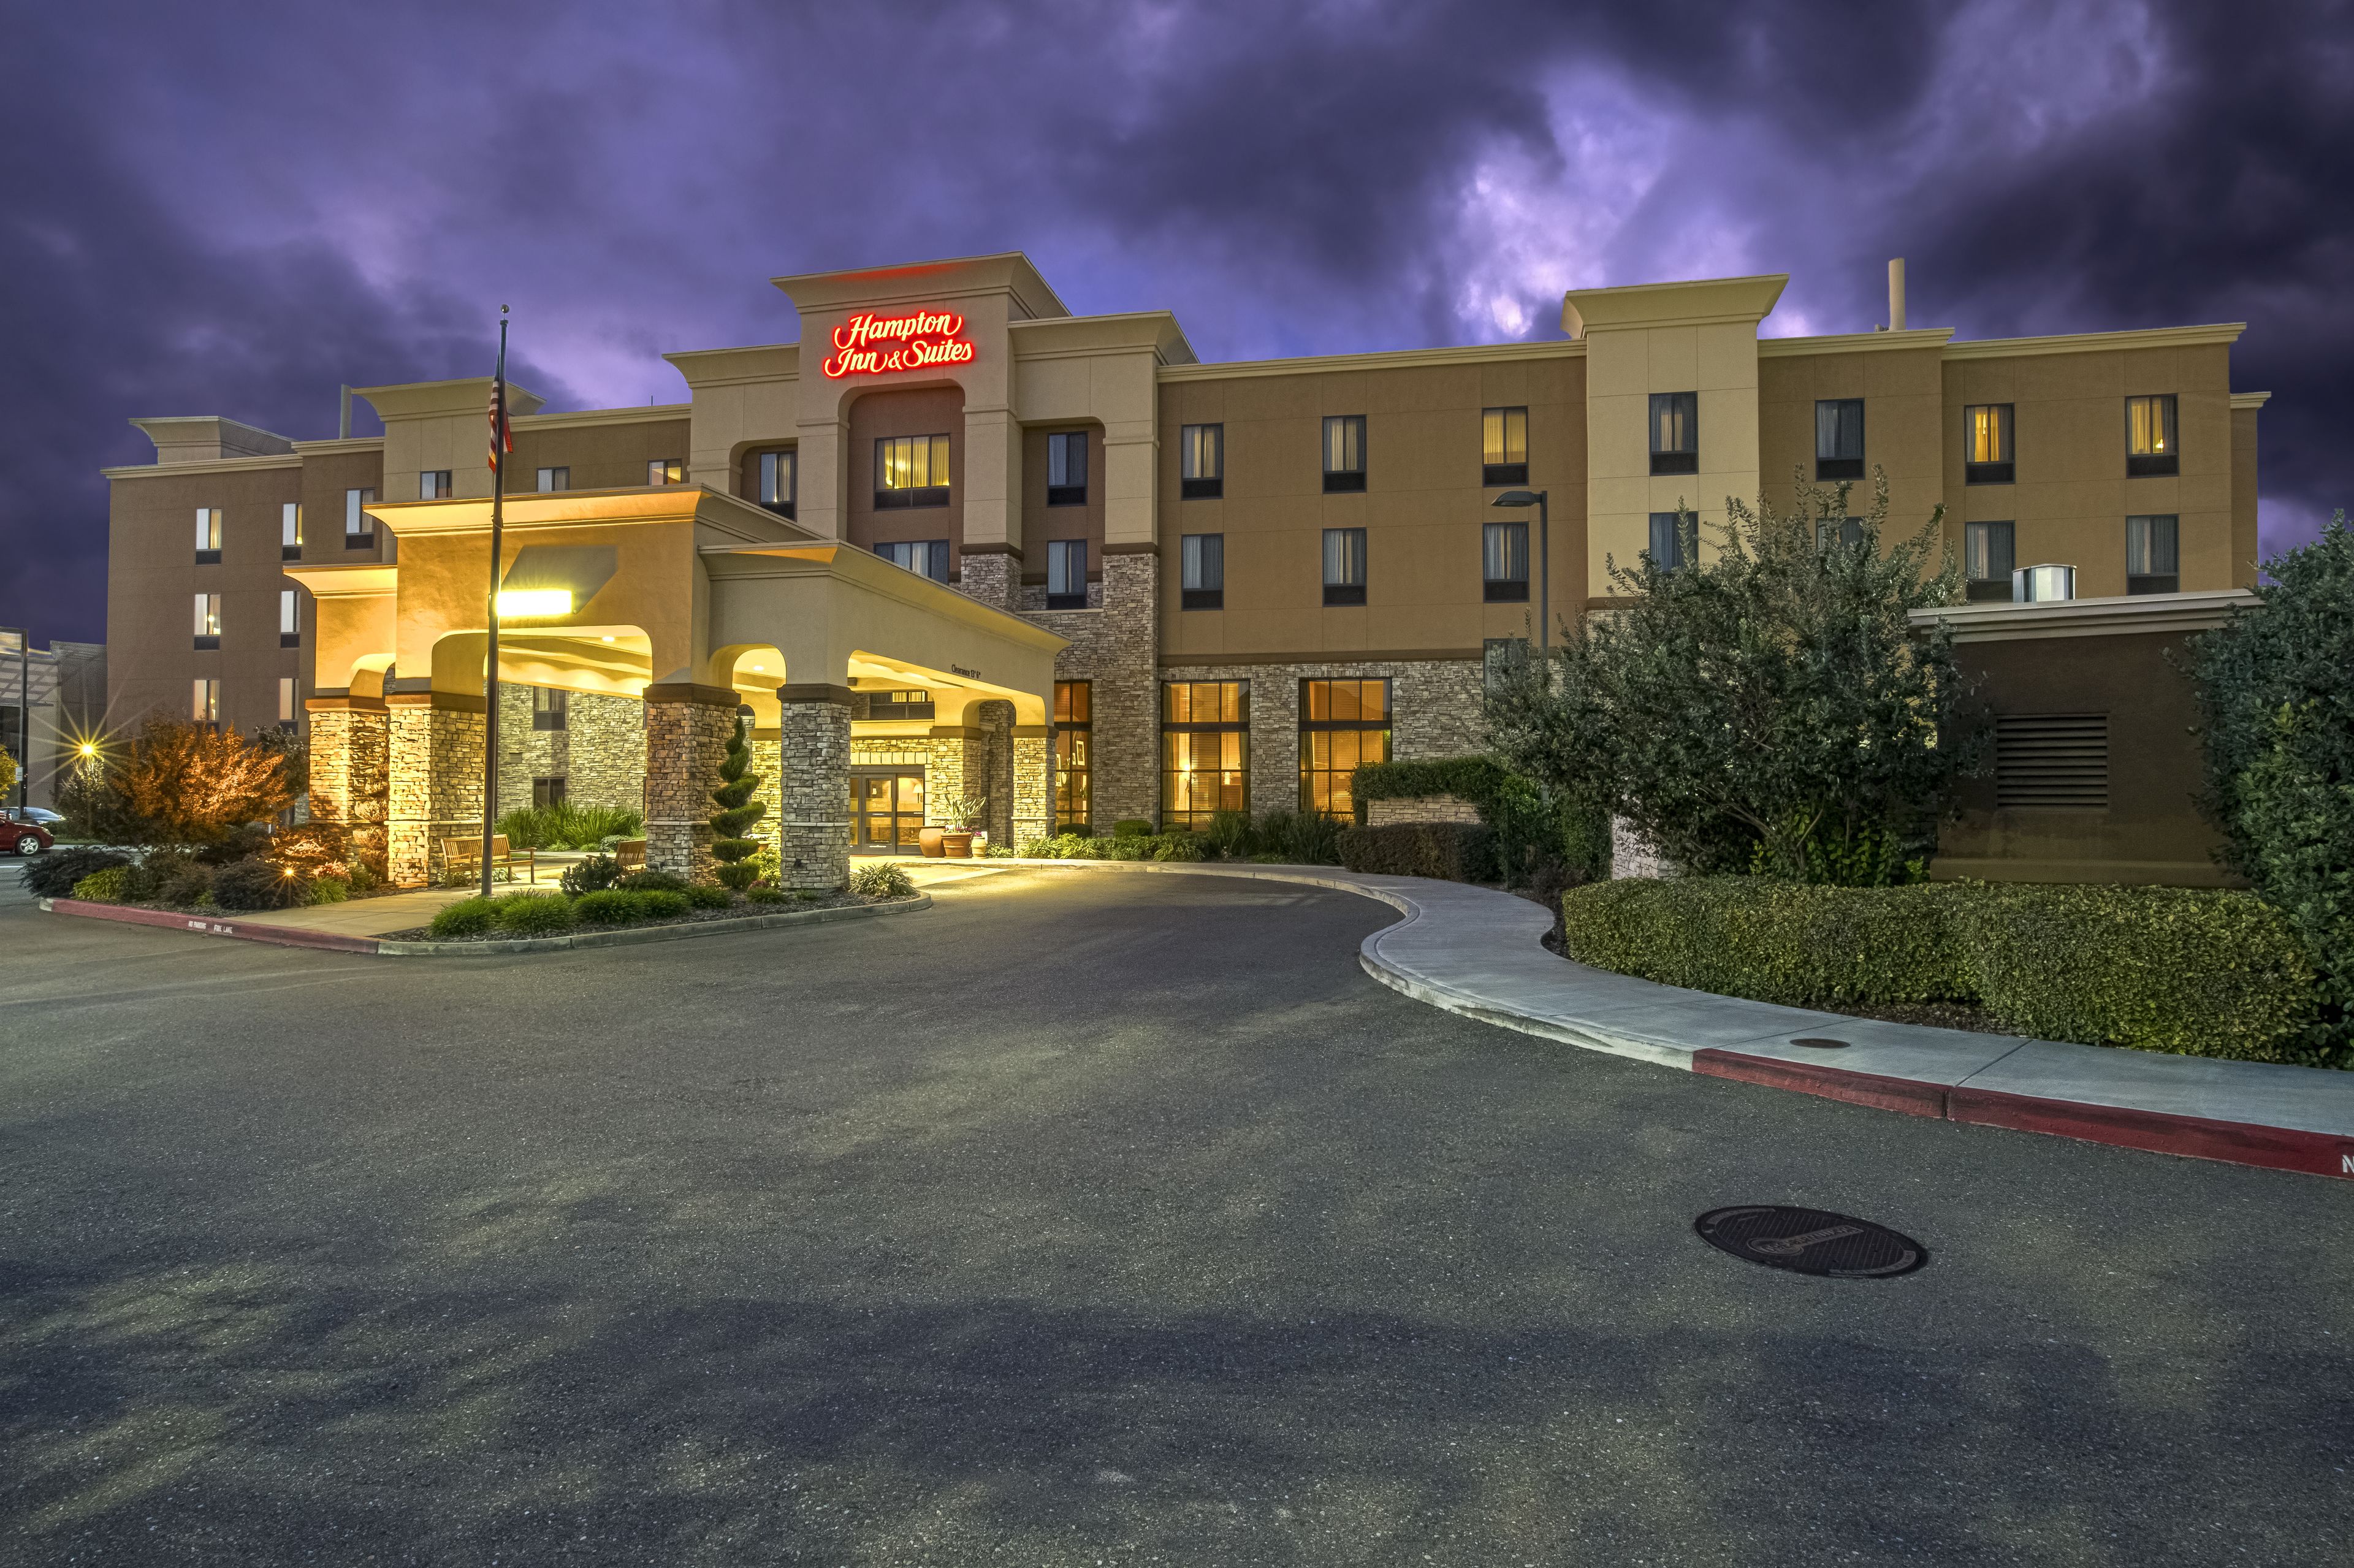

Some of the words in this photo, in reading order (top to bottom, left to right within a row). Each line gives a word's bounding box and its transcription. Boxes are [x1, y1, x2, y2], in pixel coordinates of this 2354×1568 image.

[834, 311, 962, 350] Hampton
[824, 348, 888, 377] Inn
[888, 350, 903, 370] &
[902, 338, 973, 367] Suites
[951, 664, 970, 677] Clearance
